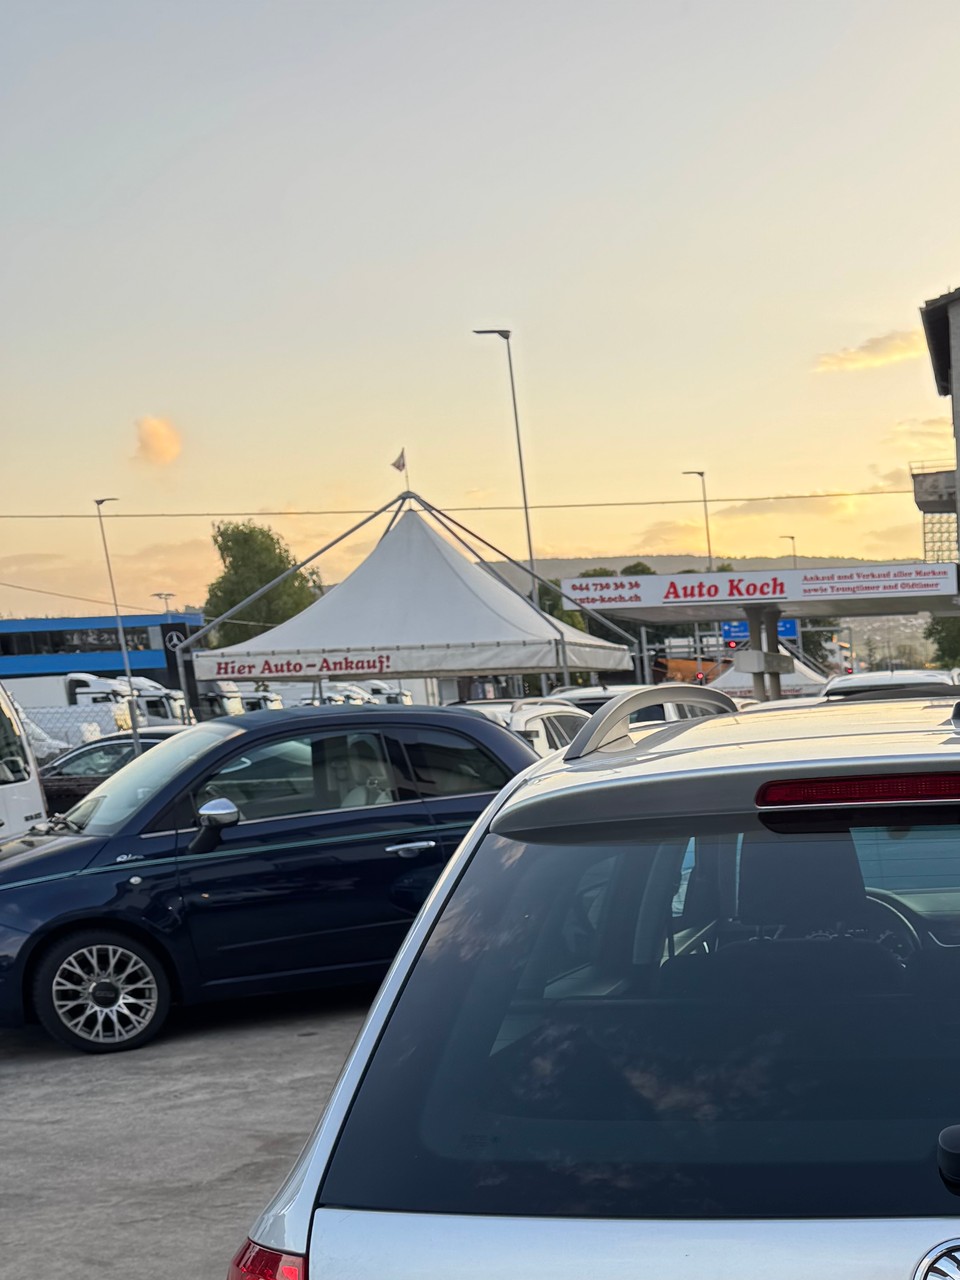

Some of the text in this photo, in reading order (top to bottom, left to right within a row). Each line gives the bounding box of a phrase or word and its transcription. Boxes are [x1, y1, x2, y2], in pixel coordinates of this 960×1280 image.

[663, 577, 786, 599] Auto Koch
[215, 660, 256, 676] Hier
